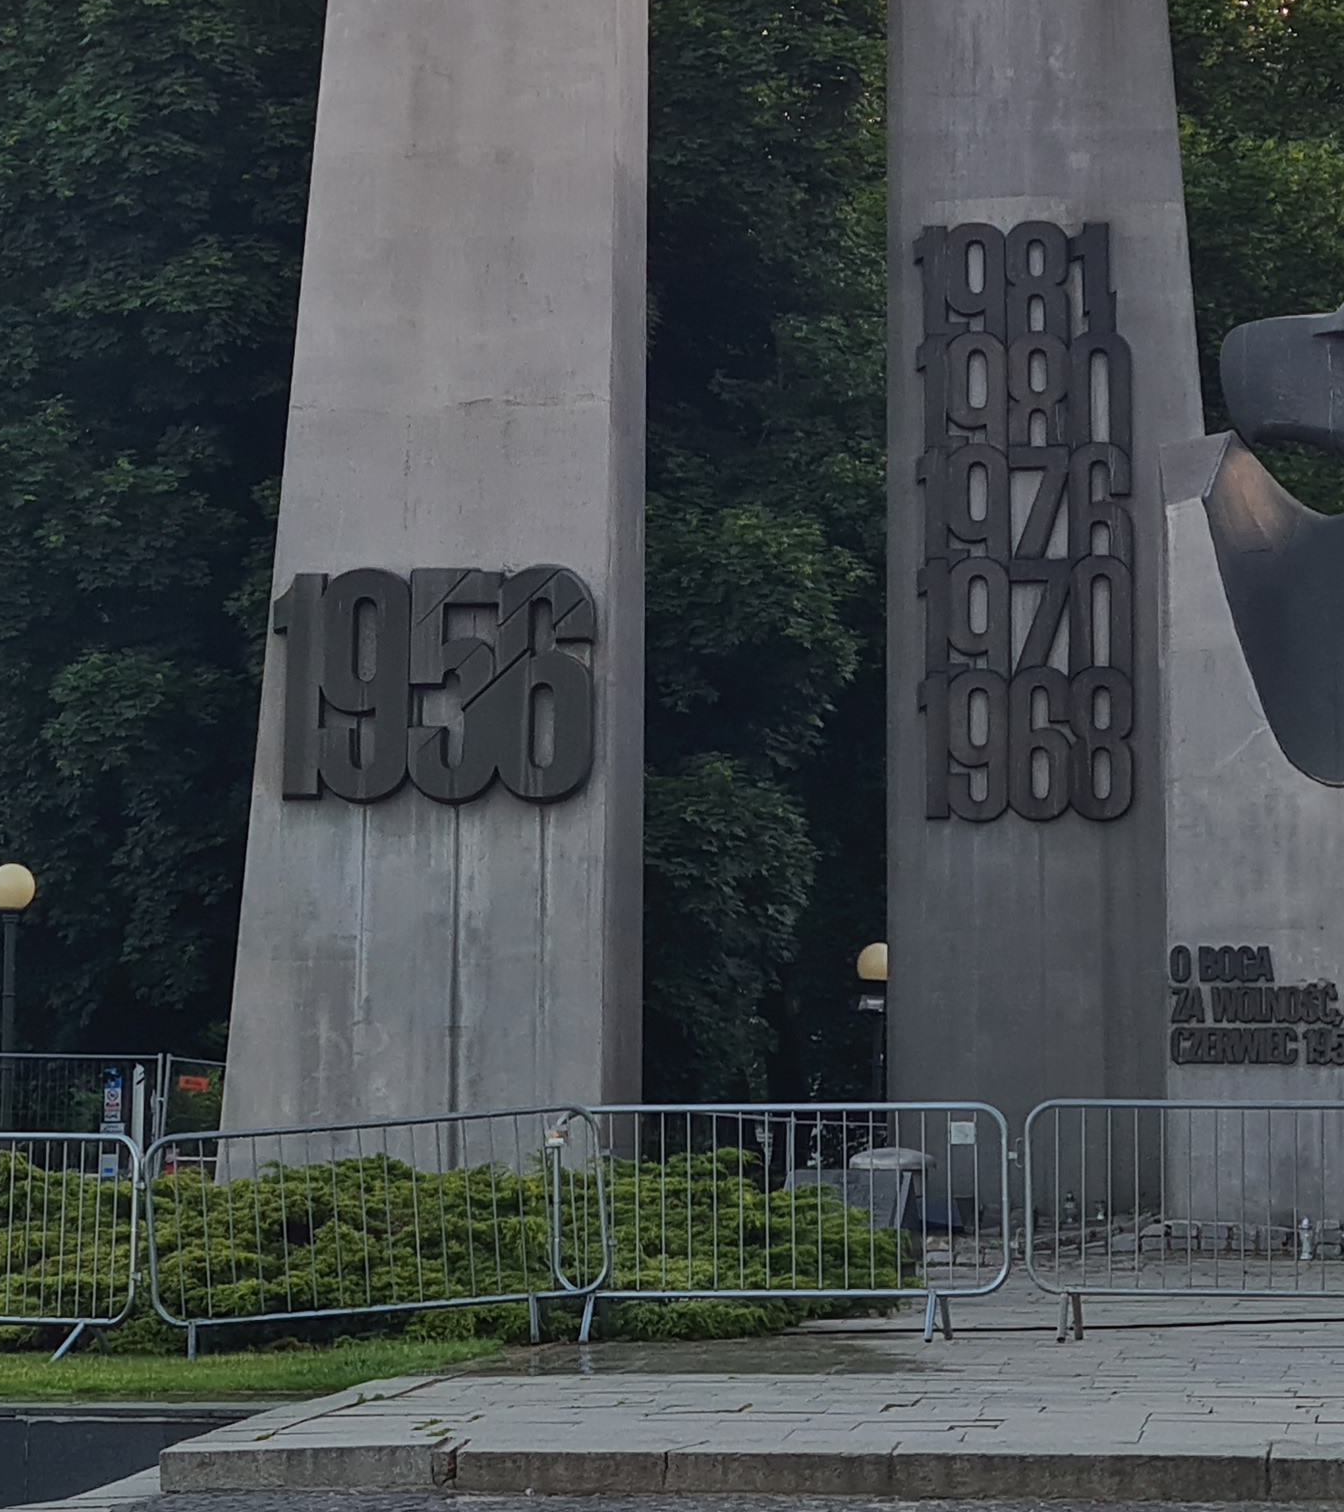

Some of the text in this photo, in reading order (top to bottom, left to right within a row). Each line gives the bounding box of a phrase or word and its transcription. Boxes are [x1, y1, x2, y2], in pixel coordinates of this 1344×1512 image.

[913, 221, 1116, 335] 1981
[915, 331, 1133, 448] 1980
[915, 441, 1133, 560] 1976
[916, 554, 1134, 674] 1970
[273, 563, 596, 804] 1956
[916, 665, 1134, 822] 1968
[1169, 945, 1275, 984] O BOGA
[1170, 987, 1205, 1024] ZA
[1170, 1027, 1299, 1065] CZERWIEC
